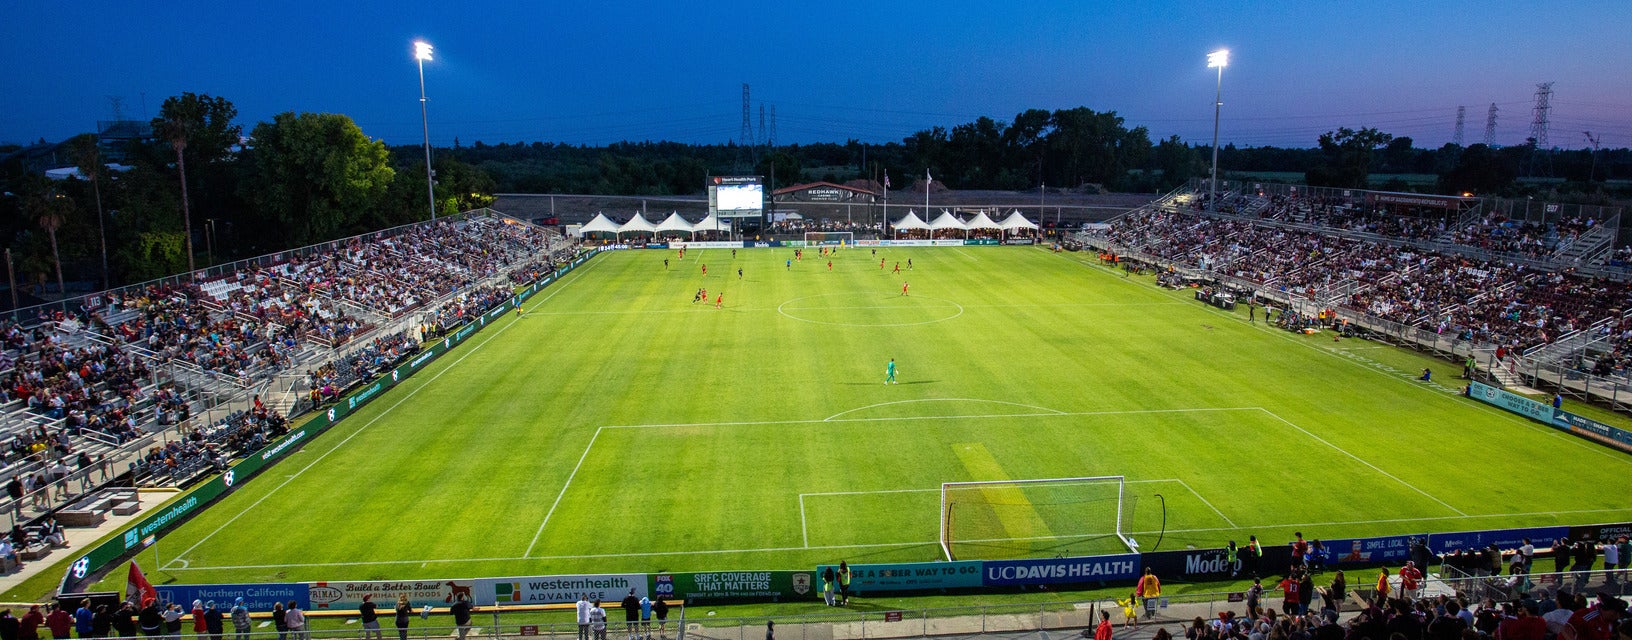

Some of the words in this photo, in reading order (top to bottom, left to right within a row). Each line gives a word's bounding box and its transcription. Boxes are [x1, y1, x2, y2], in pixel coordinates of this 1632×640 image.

[140, 496, 197, 536] westernhealth
[1600, 526, 1631, 535] OFFICIAL
[1068, 561, 1133, 577] HEALTH
[1185, 554, 1242, 574] Modeo
[916, 567, 939, 576] WAY
[941, 567, 956, 575] TO
[959, 566, 979, 574] GO.
[694, 573, 718, 583] SRFC
[721, 572, 771, 582] COVERAGE
[346, 583, 372, 591] Build
[381, 582, 412, 591] Better
[414, 582, 441, 590] Bowl
[529, 577, 628, 590] westernhealth
[656, 583, 674, 593] 40
[697, 582, 722, 591] THAT
[724, 581, 769, 590] MATTERS
[1290, 583, 1298, 593] 13
[198, 589, 244, 598] Northern
[246, 588, 295, 597] California
